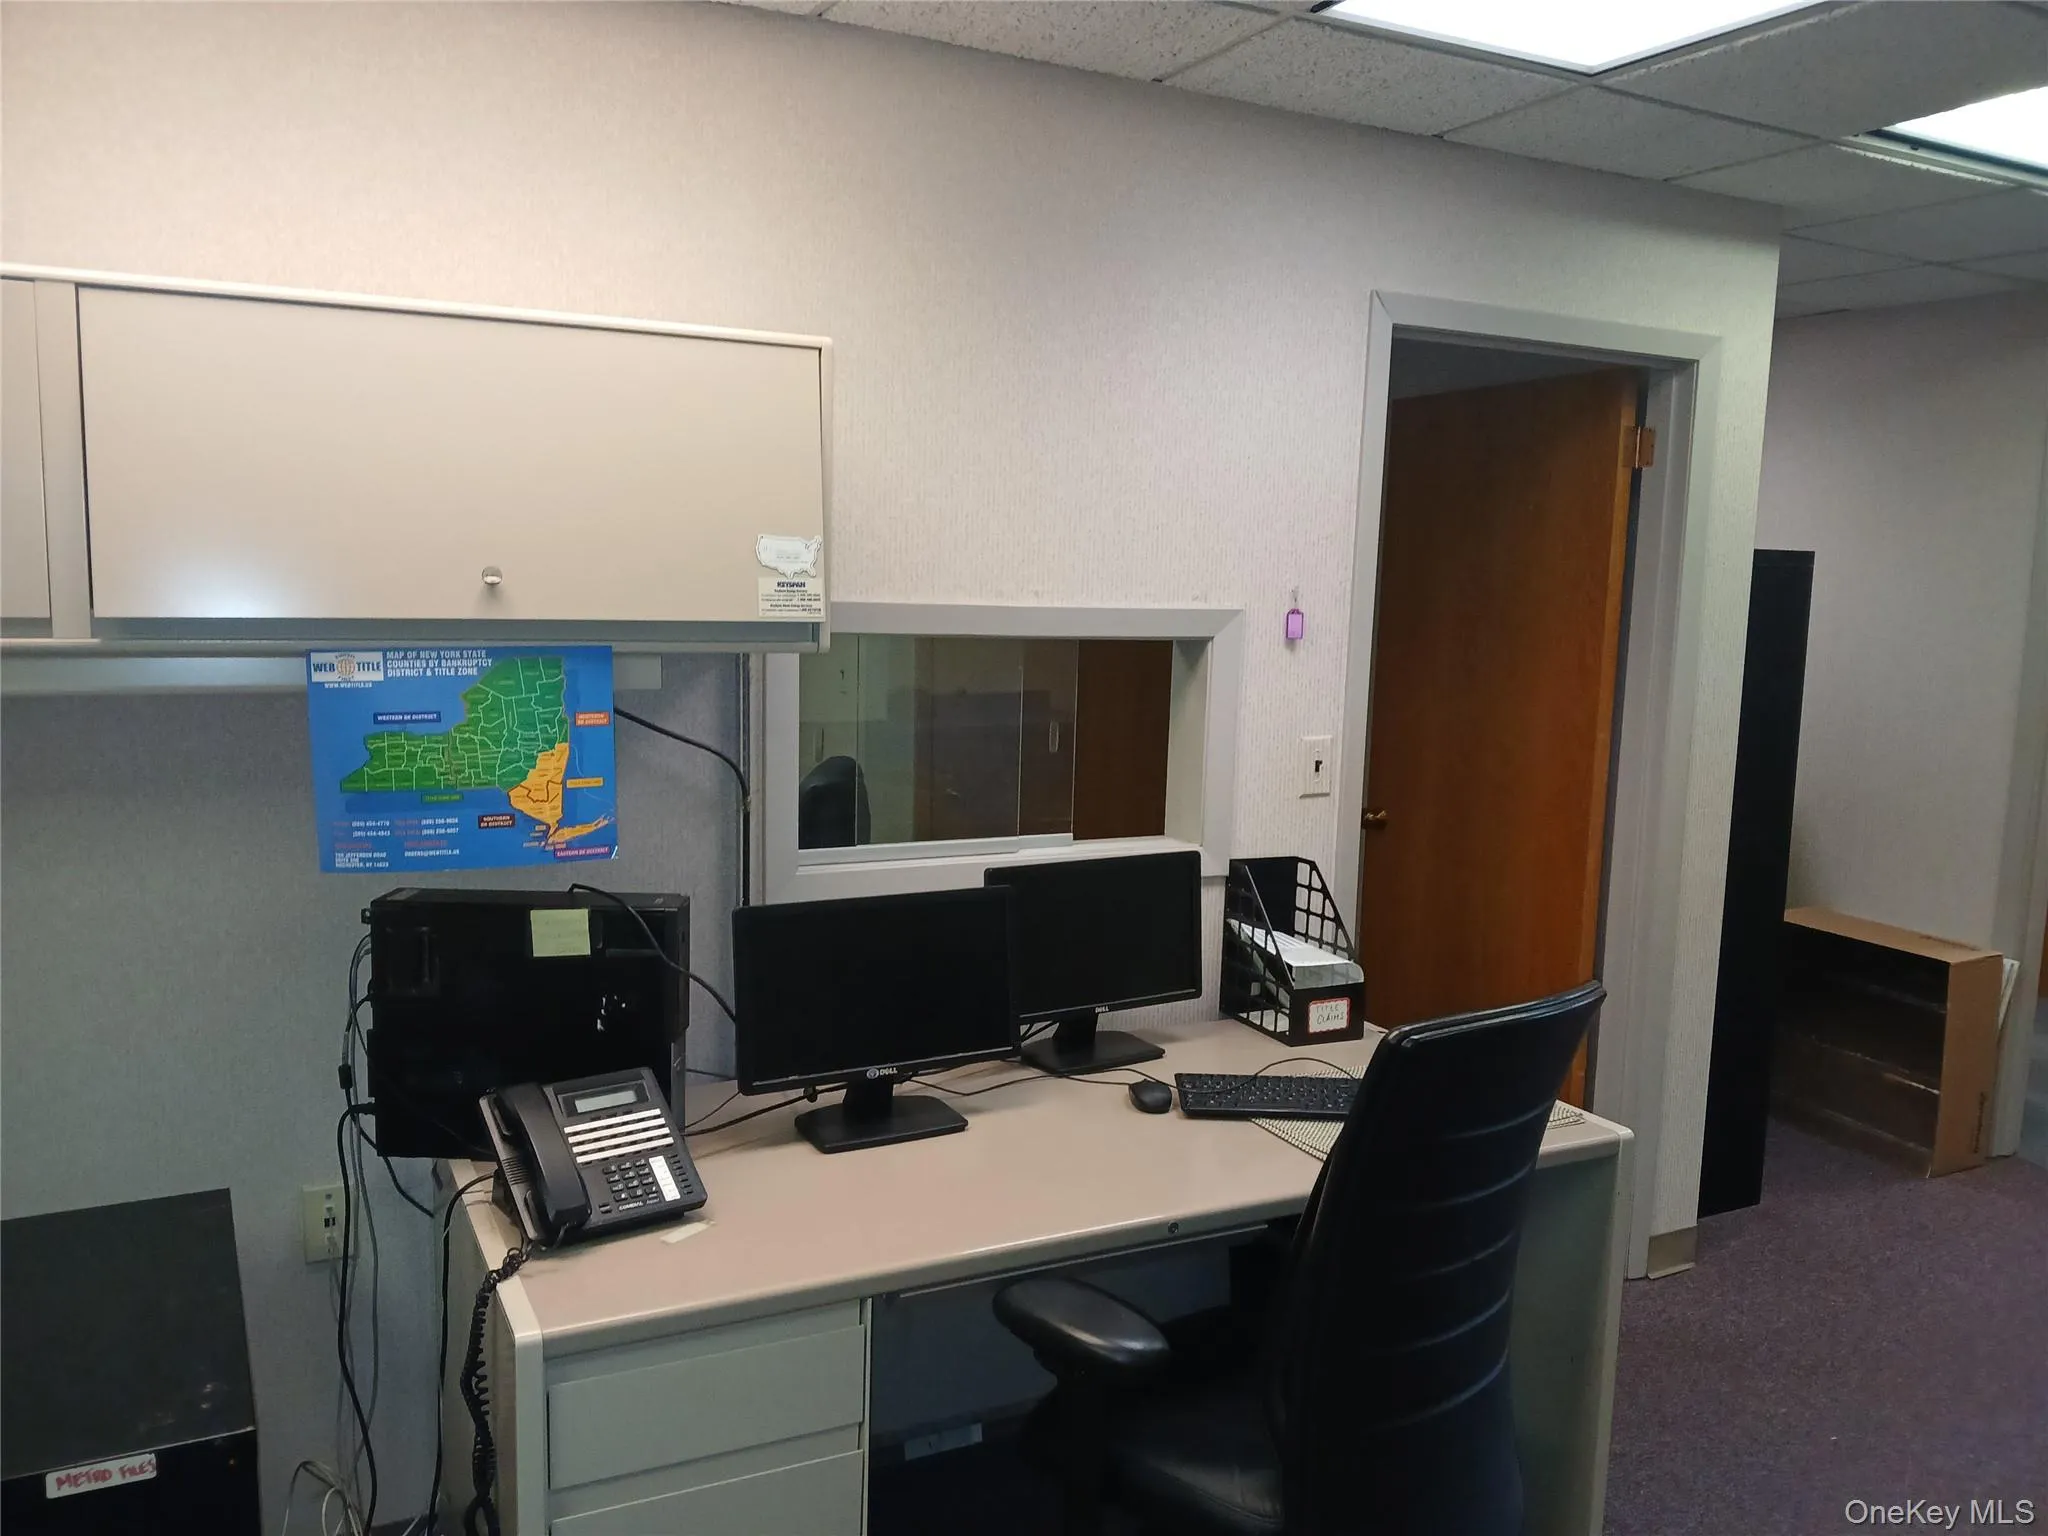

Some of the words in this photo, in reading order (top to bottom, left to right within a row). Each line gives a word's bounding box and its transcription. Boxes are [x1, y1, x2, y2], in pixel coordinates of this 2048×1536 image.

[386, 650, 405, 659] MAP
[406, 650, 417, 659] OF
[420, 650, 438, 659] NEW
[440, 650, 461, 659] YORK
[462, 649, 487, 658] STATE
[312, 662, 336, 673] WEB
[356, 661, 382, 672] TITLE
[387, 659, 427, 668] COUNTIES
[428, 659, 439, 668] BY
[441, 658, 493, 667] BANKRUPTCY
[387, 668, 424, 677] DISTRICT
[425, 668, 433, 677] &
[434, 667, 456, 676] TITLE
[457, 667, 478, 676] ZONE
[879, 1067, 898, 1076] DELL
